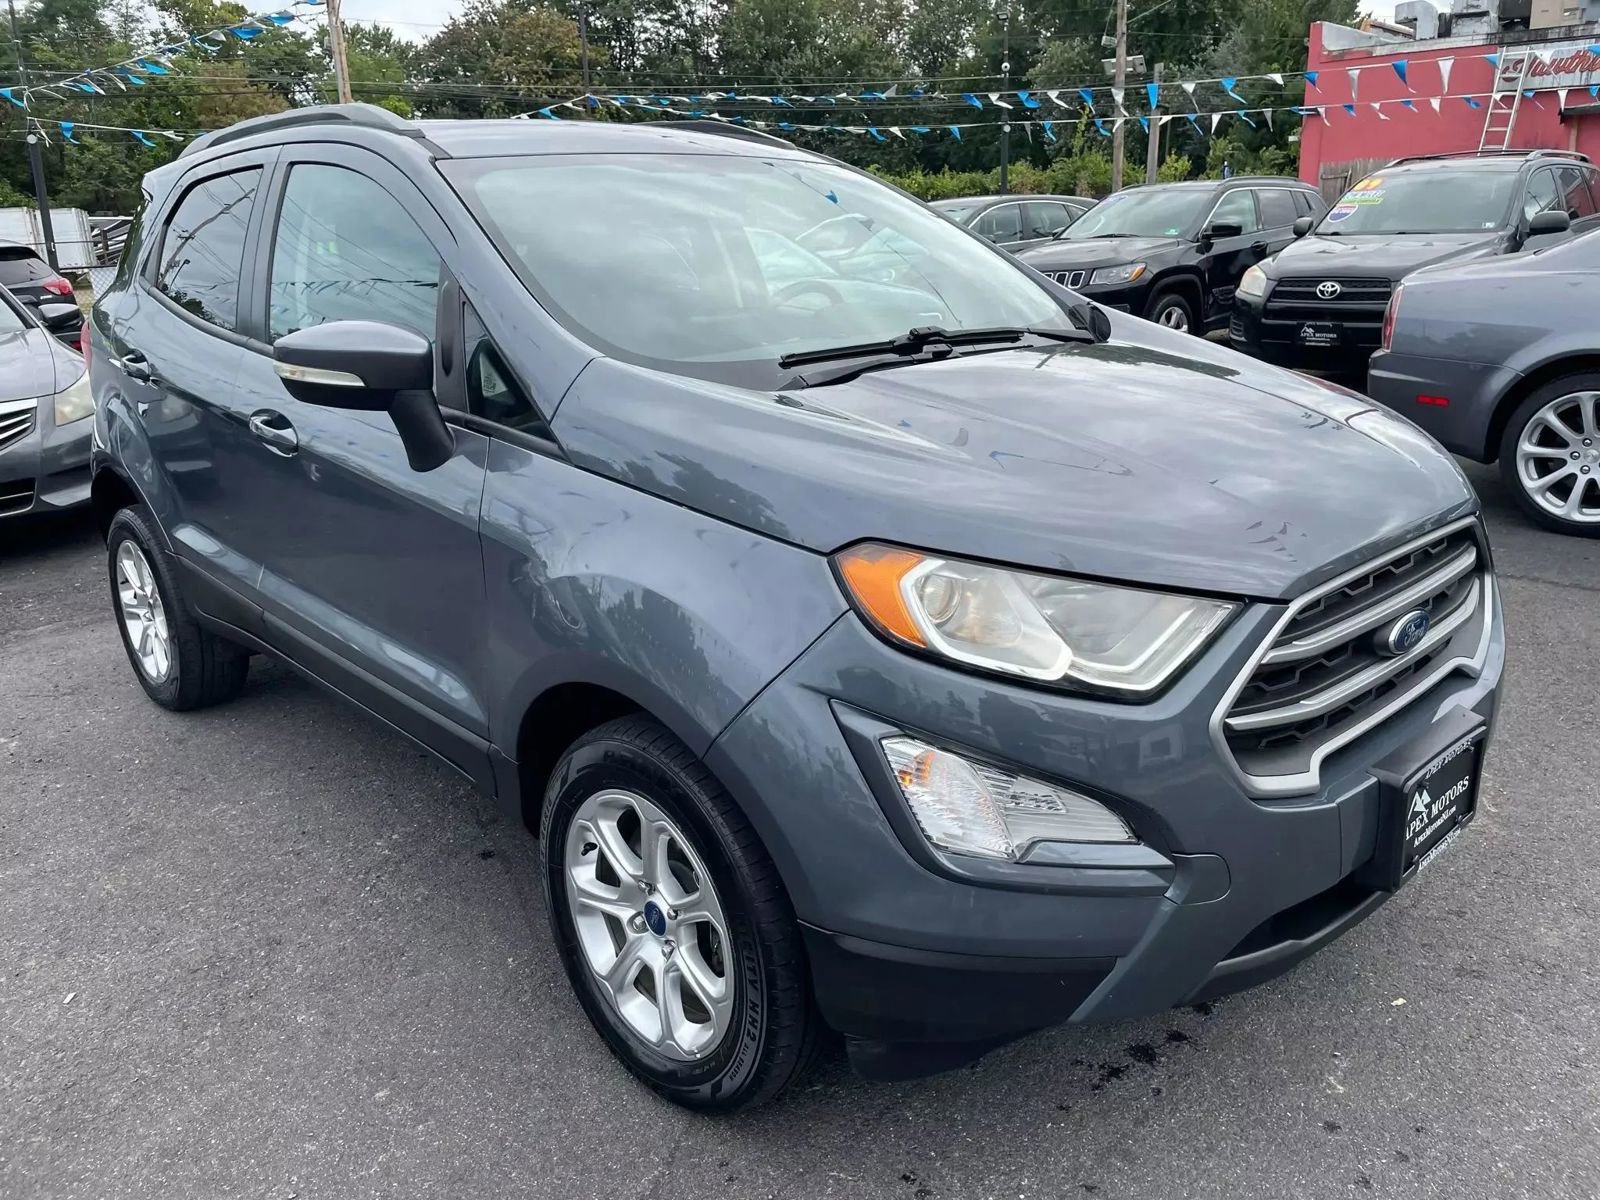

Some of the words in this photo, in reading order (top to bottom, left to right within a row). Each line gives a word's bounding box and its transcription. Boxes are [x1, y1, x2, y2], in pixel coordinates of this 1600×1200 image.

[1405, 808, 1429, 841] APEX
[1430, 775, 1470, 819] MOTORS
[747, 1002, 760, 1043] HH2
